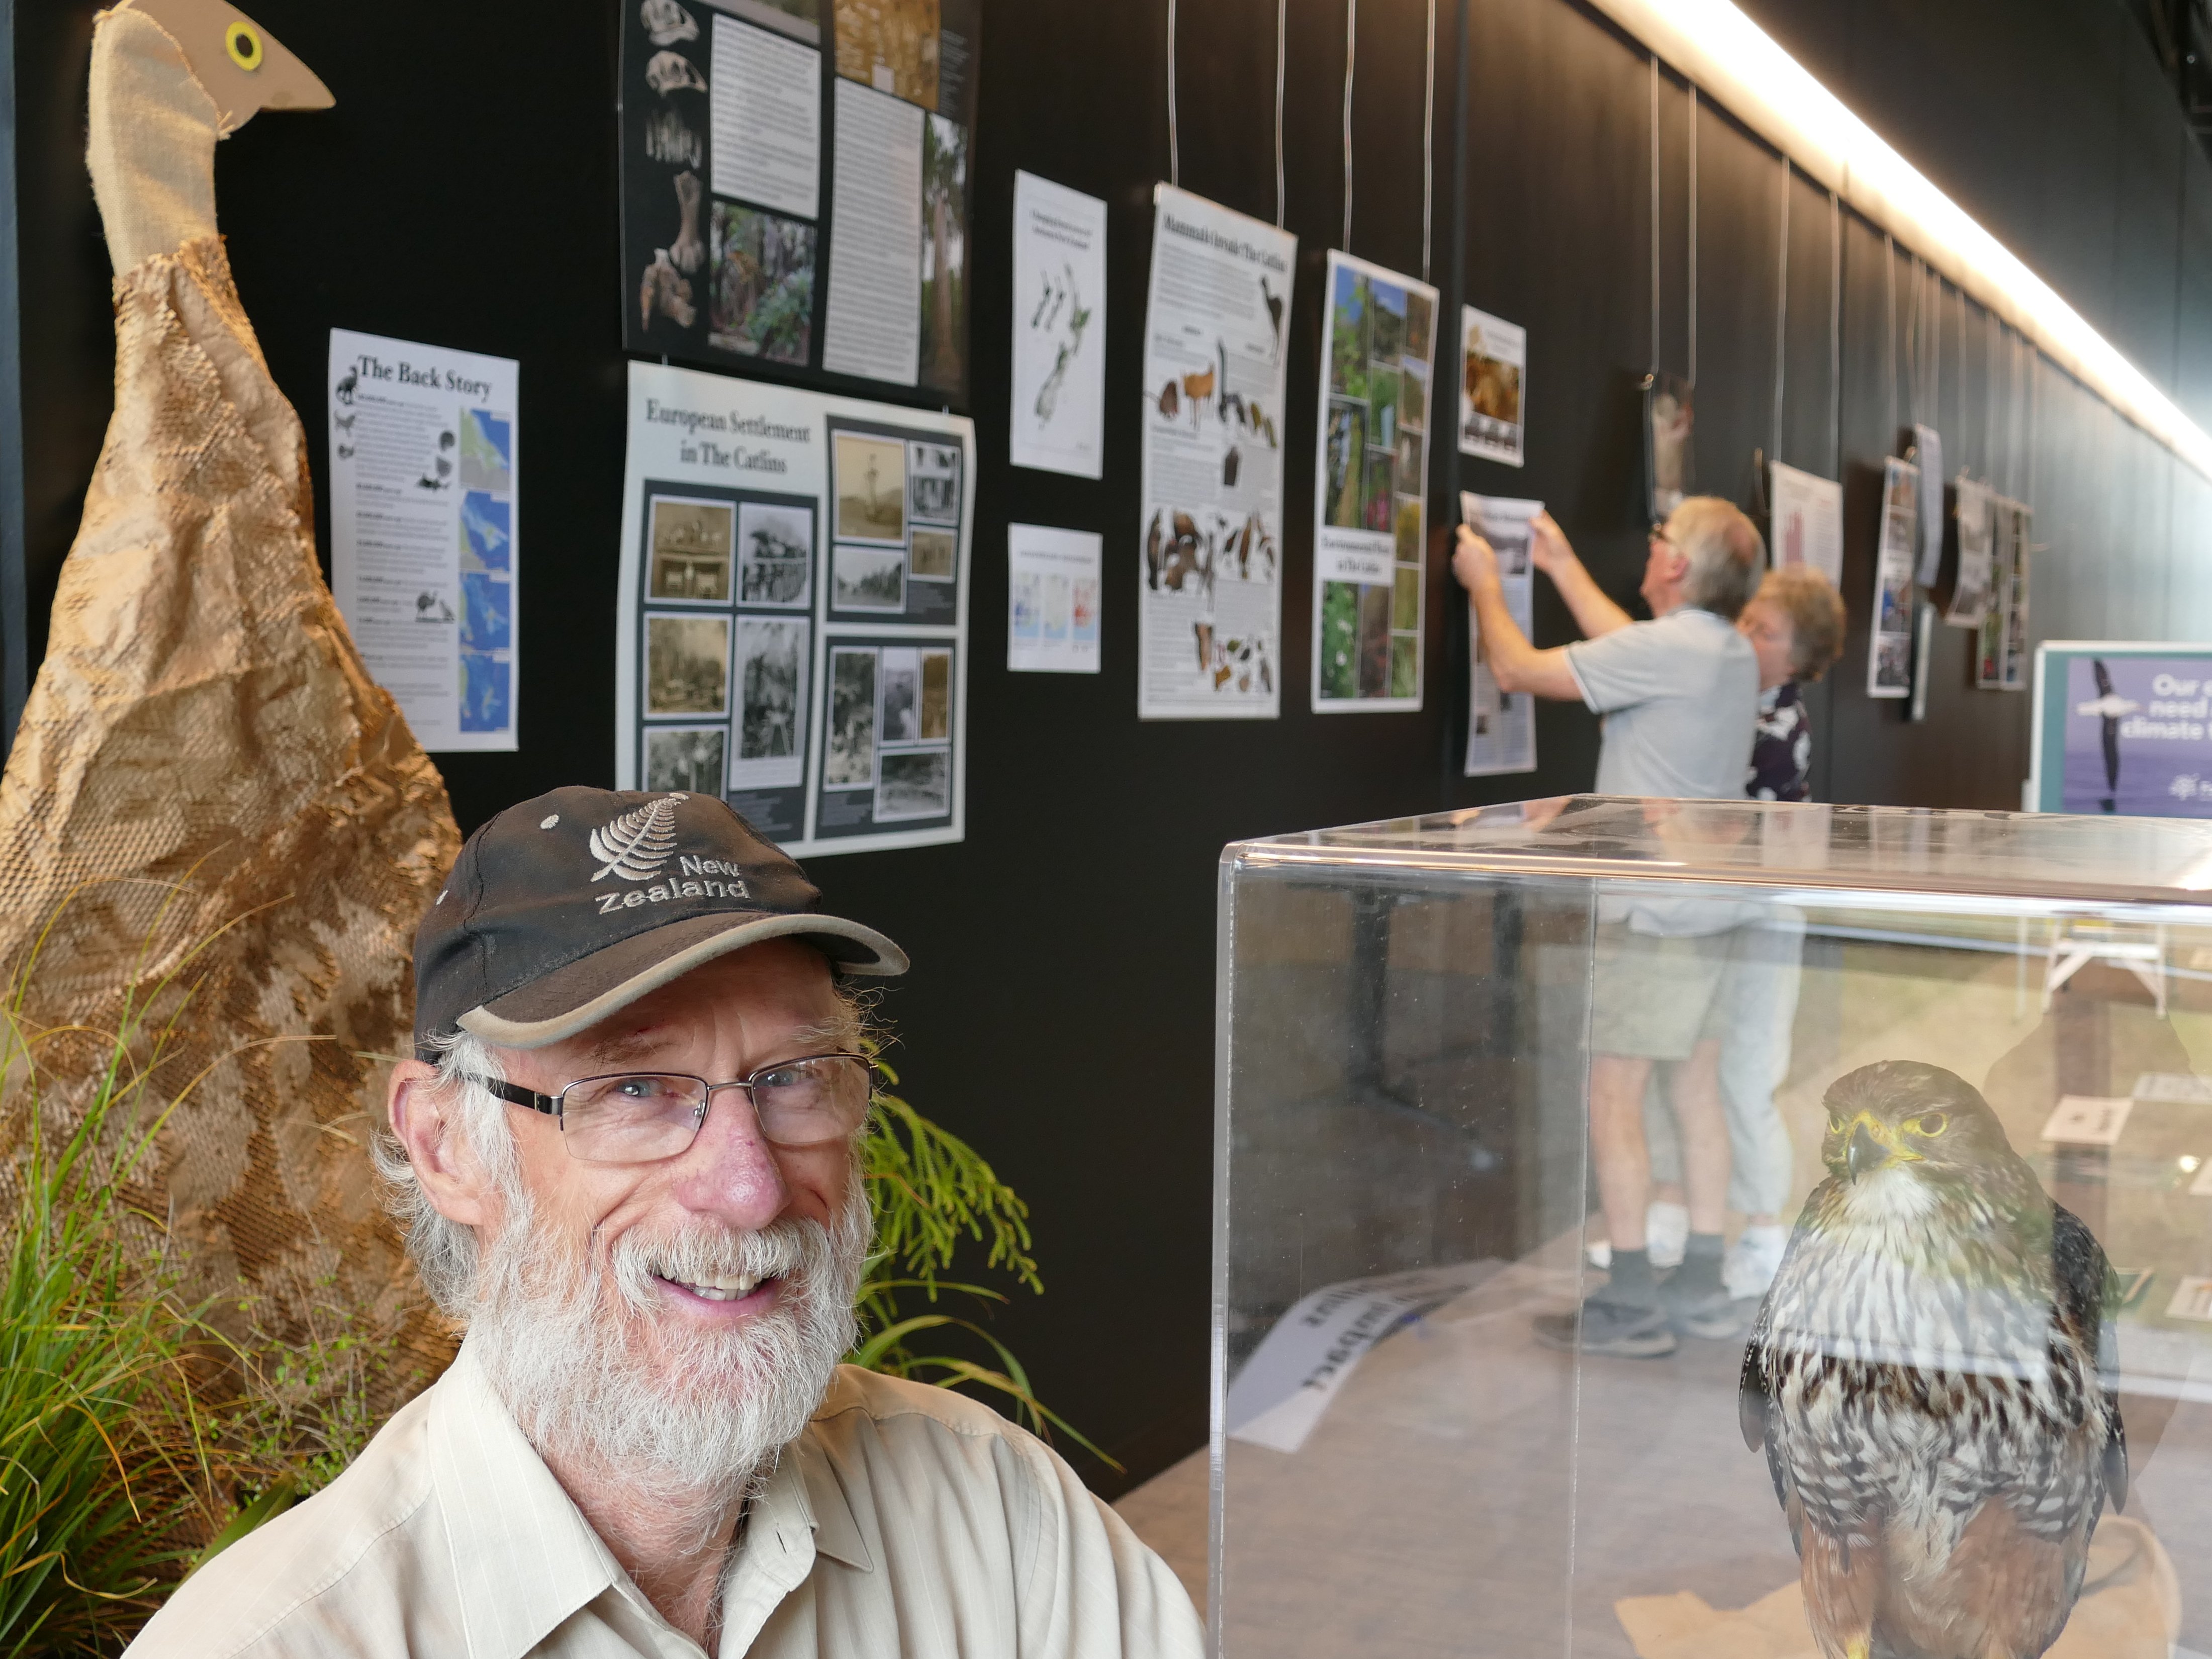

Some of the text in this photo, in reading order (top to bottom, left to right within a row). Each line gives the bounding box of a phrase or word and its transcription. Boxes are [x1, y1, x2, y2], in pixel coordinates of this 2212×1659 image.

[357, 354, 492, 403] The Back Story
[646, 397, 810, 443] European Settlement
[680, 439, 787, 474] in The Catlins
[2152, 673, 2200, 697] Our
[2148, 697, 2208, 719] need
[2120, 715, 2204, 741] climate
[679, 855, 740, 877] New
[595, 877, 751, 915] Zealand
